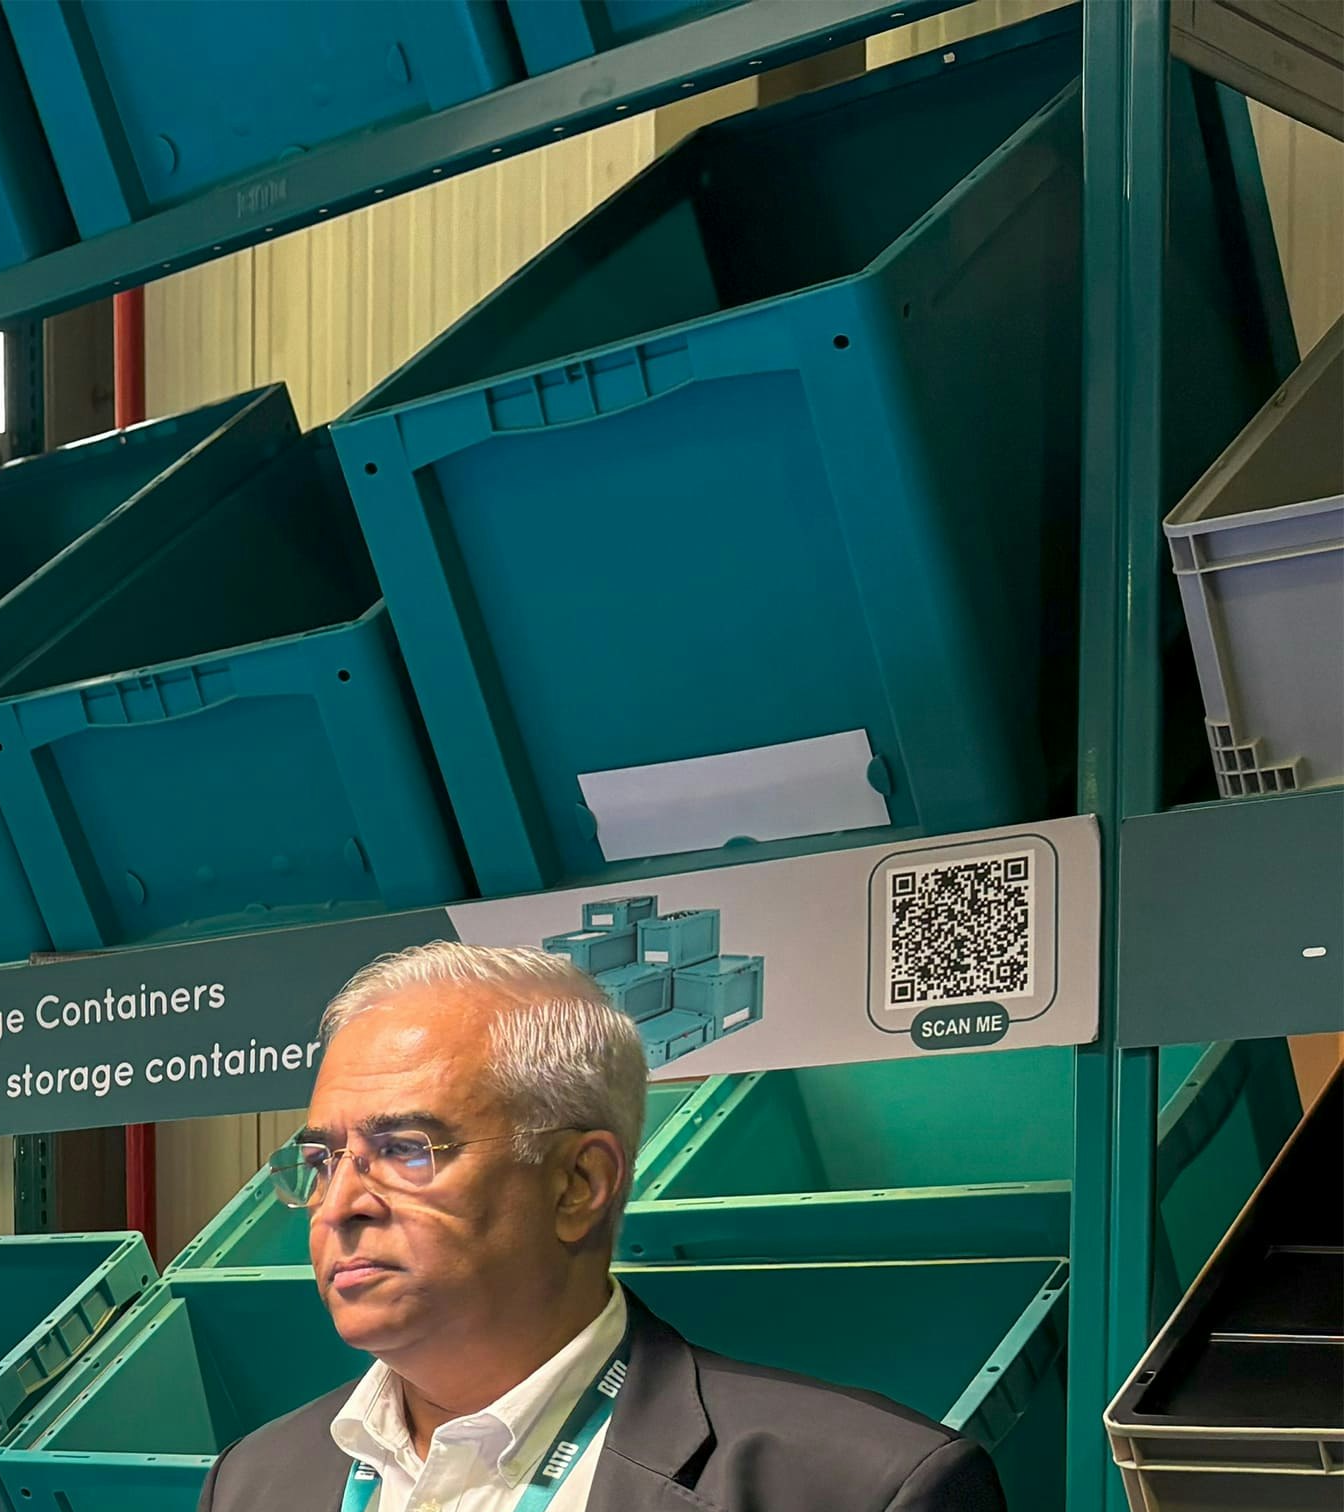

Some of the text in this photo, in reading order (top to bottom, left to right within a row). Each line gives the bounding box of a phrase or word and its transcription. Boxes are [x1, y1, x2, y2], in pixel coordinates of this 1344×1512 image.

[36, 982, 226, 1030] Containers
[921, 1014, 1004, 1038] SCAN ME
[6, 1061, 135, 1098] storage
[542, 1440, 580, 1480] BITO
